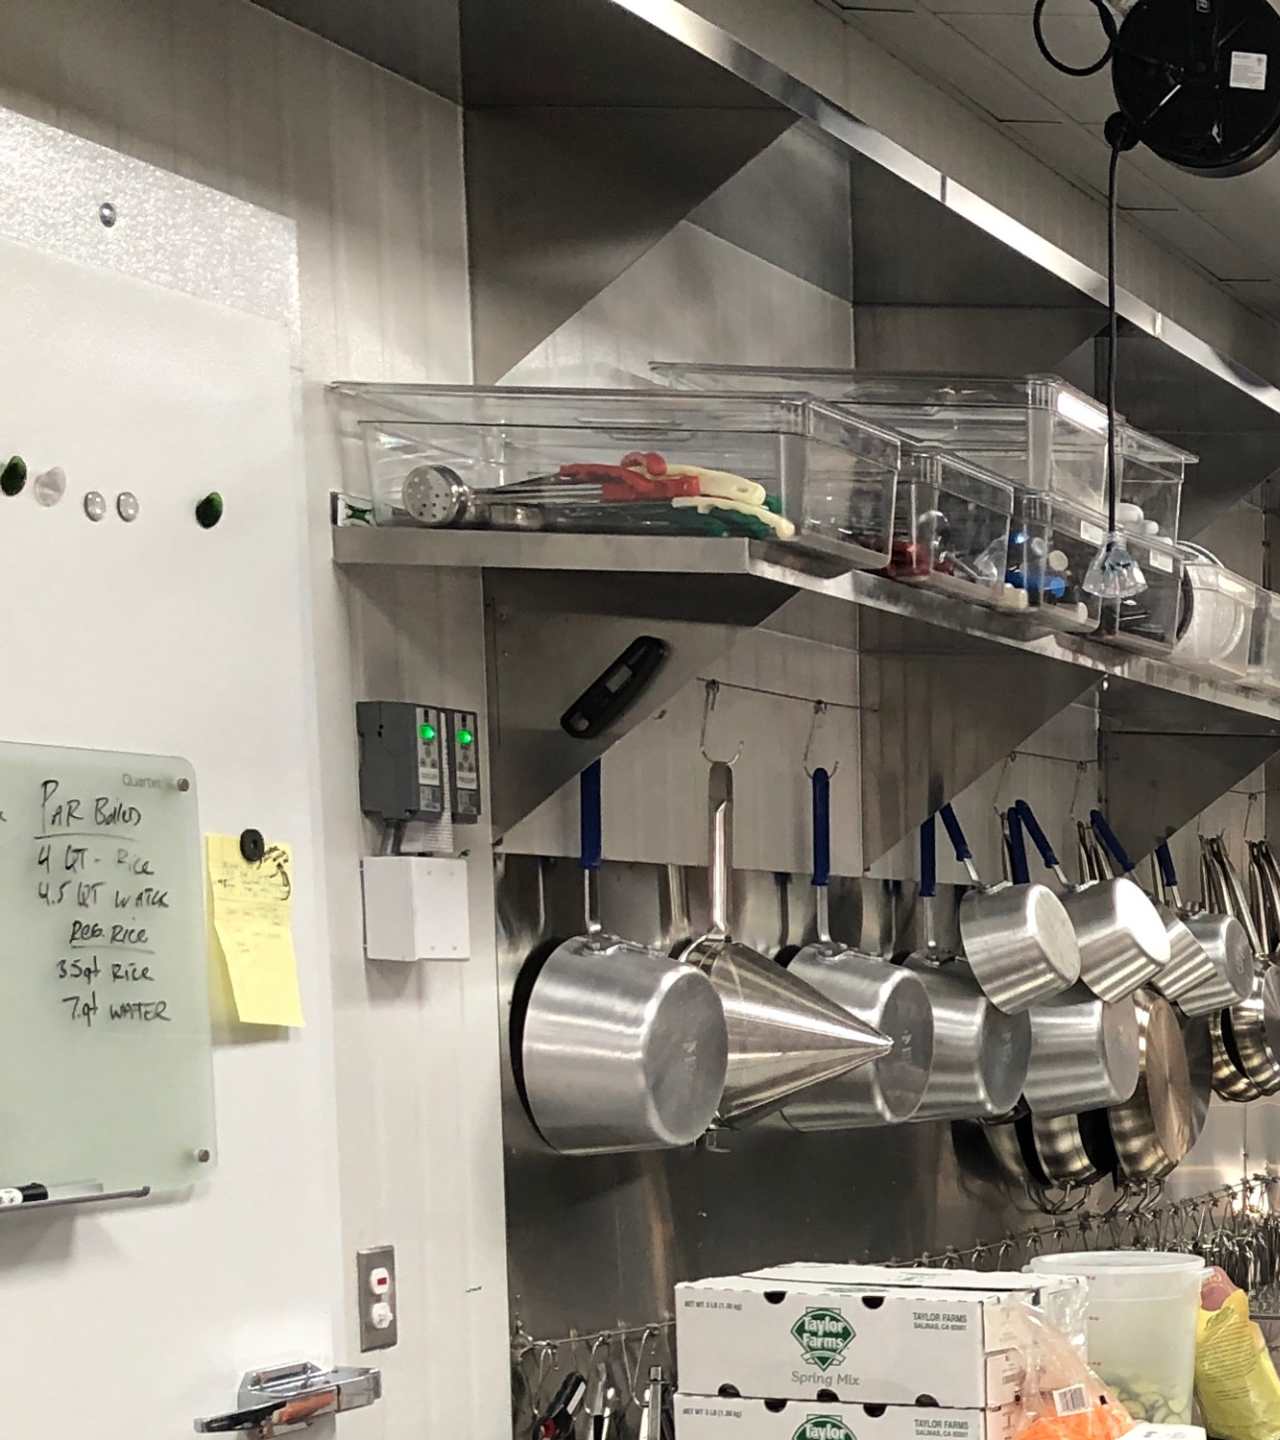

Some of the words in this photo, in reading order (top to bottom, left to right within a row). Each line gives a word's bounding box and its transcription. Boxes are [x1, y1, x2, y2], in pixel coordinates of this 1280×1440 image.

[38, 845, 51, 872] 4
[803, 1316, 844, 1334] Taylor
[912, 1312, 940, 1322] TAYLOR
[943, 1313, 967, 1323] FARMS
[802, 1333, 844, 1349] Farms
[792, 1371, 833, 1386] Spring
[837, 1373, 860, 1386] Mix
[914, 1419, 941, 1428] TAYLOR
[944, 1421, 968, 1430] FARMS
